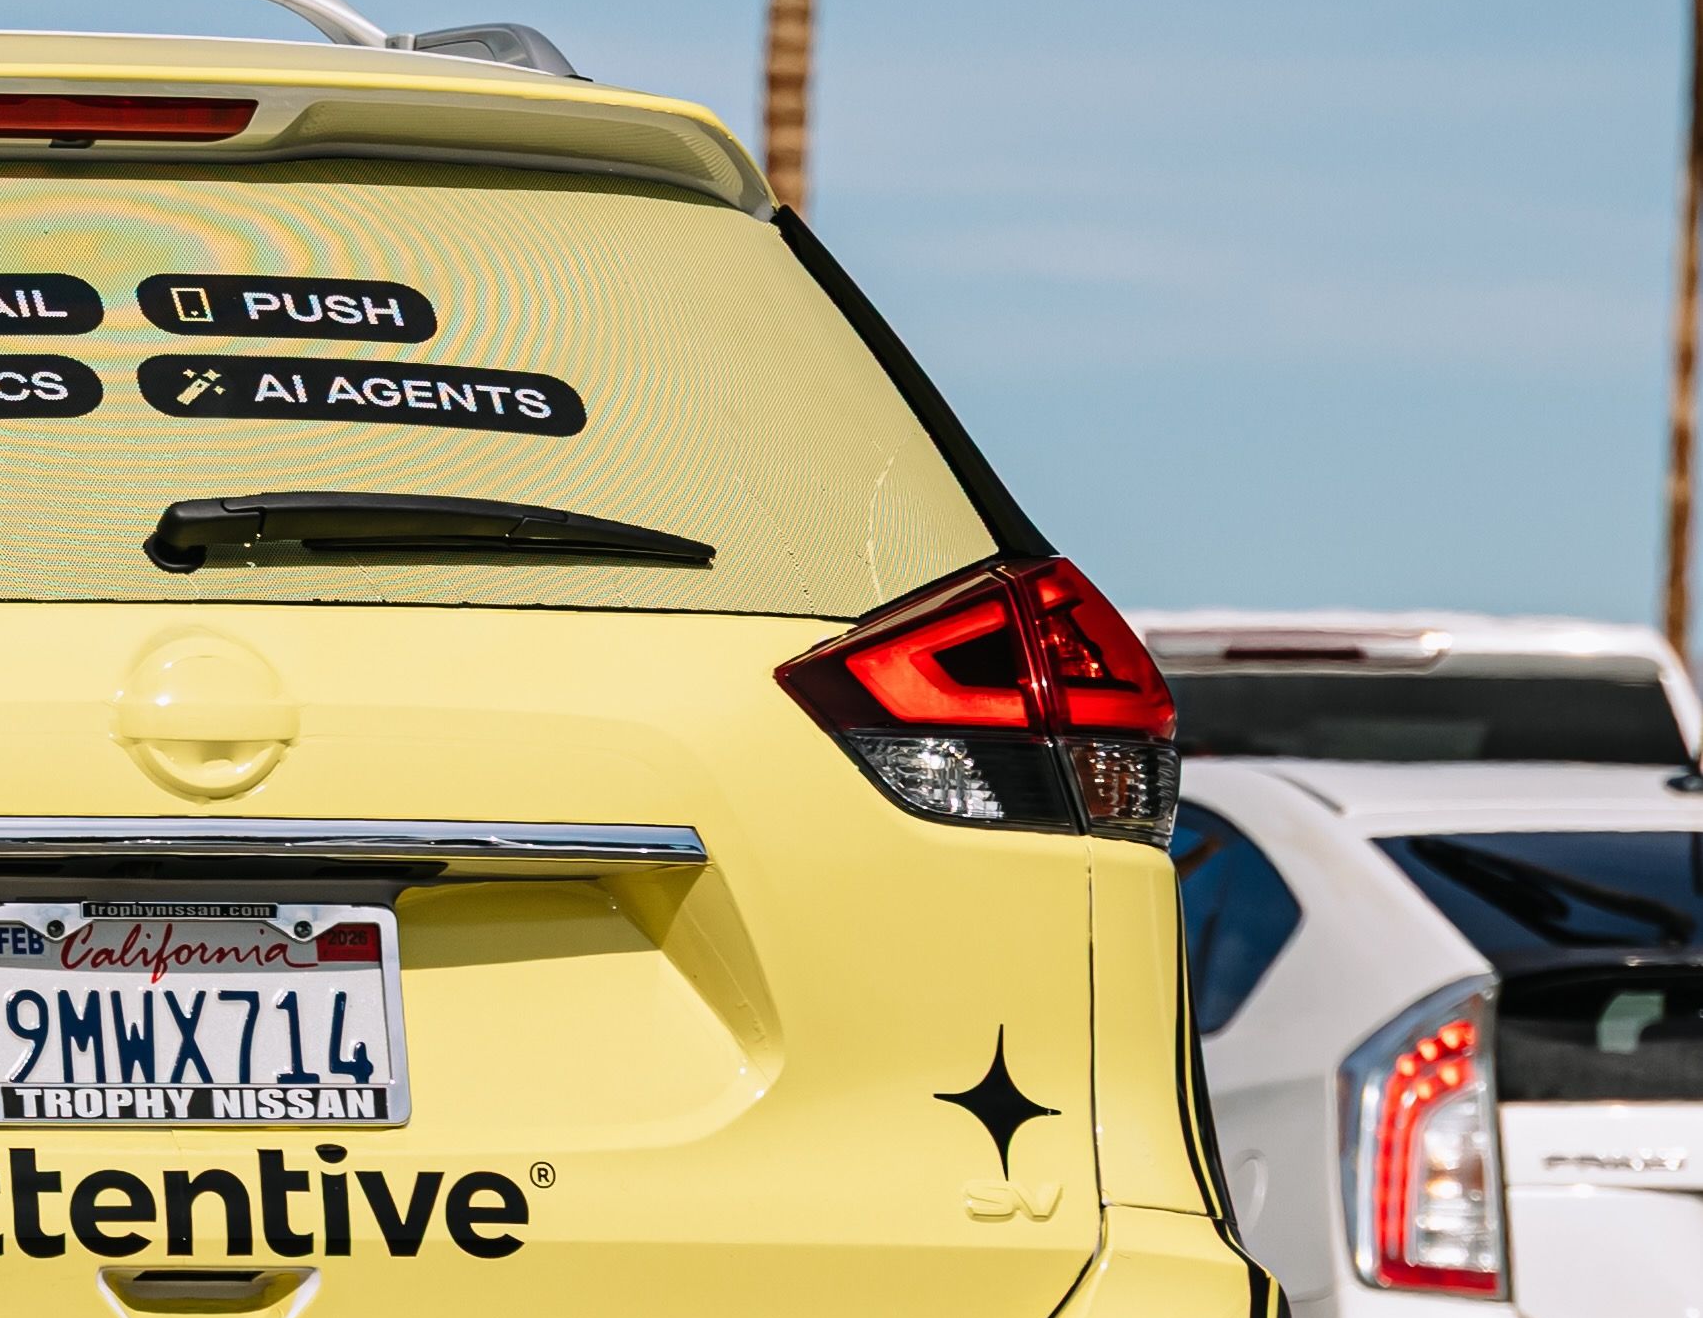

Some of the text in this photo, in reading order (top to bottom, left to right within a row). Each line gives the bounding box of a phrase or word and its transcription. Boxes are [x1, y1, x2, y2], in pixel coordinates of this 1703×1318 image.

[241, 291, 407, 329] PUSH
[253, 372, 555, 420] AI AGENTS
[89, 903, 271, 919] trophynissan.com
[61, 921, 319, 984] California
[5, 988, 375, 1084] 9MWX714
[14, 1087, 376, 1120] TROPHY NISSAN
[962, 1181, 1064, 1223] SV
